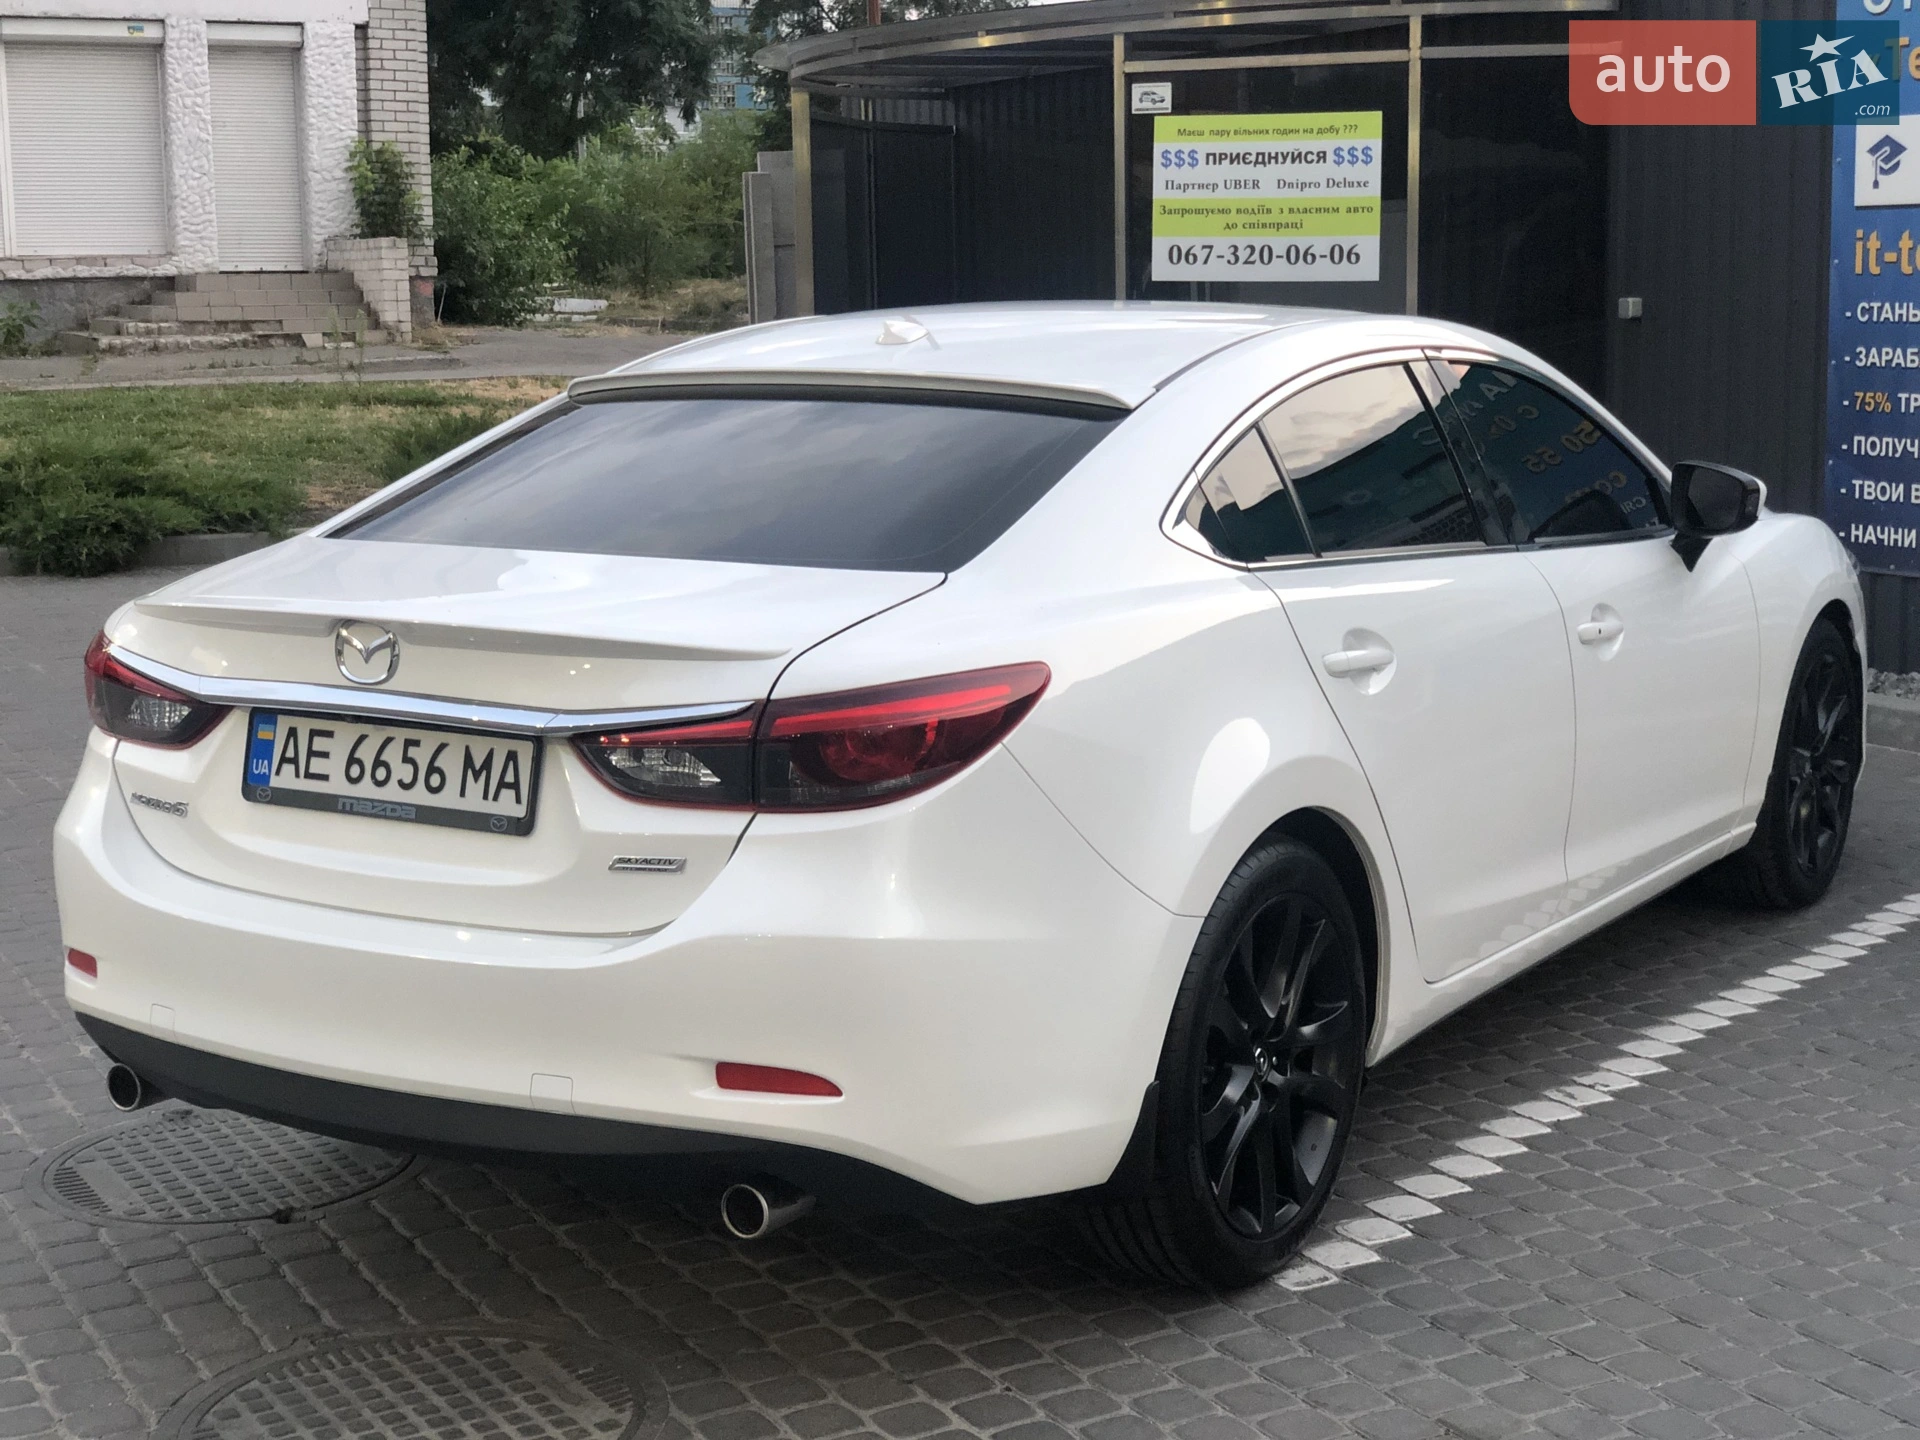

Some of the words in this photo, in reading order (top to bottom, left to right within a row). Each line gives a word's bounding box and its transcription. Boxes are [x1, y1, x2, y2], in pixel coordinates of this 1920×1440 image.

[1177, 127, 1204, 137] Маєш
[1209, 128, 1230, 138] пару
[1233, 127, 1269, 136] вільних
[1272, 127, 1300, 136] годин
[1303, 127, 1315, 135] на
[1316, 126, 1340, 137] добу
[1343, 124, 1358, 134] ???
[1205, 148, 1327, 167] ПРИЄДНУЙСЯ
[1164, 179, 1219, 192] Партнер
[1223, 179, 1261, 190] UBER
[1276, 178, 1321, 191] Dnipro
[1326, 177, 1370, 189] Deluxe
[1159, 205, 1232, 218] Запрошуємо
[1235, 205, 1273, 216] водіїв
[1288, 206, 1340, 214] власним
[1345, 205, 1374, 214] авто
[1223, 221, 1238, 231] до
[1242, 219, 1303, 232] співпраці
[1168, 243, 1361, 265] 067-320-06-06
[1855, 347, 1920, 368] ЗАРАБ
[1854, 392, 1891, 413] 75%
[1851, 479, 1904, 503] ТВОИ
[1850, 523, 1917, 548] НАЧНИ
[252, 758, 269, 776] UA
[274, 726, 335, 782] AE
[344, 733, 450, 794] 6656
[459, 744, 522, 805] MA
[616, 857, 677, 866] SKYACTIV
